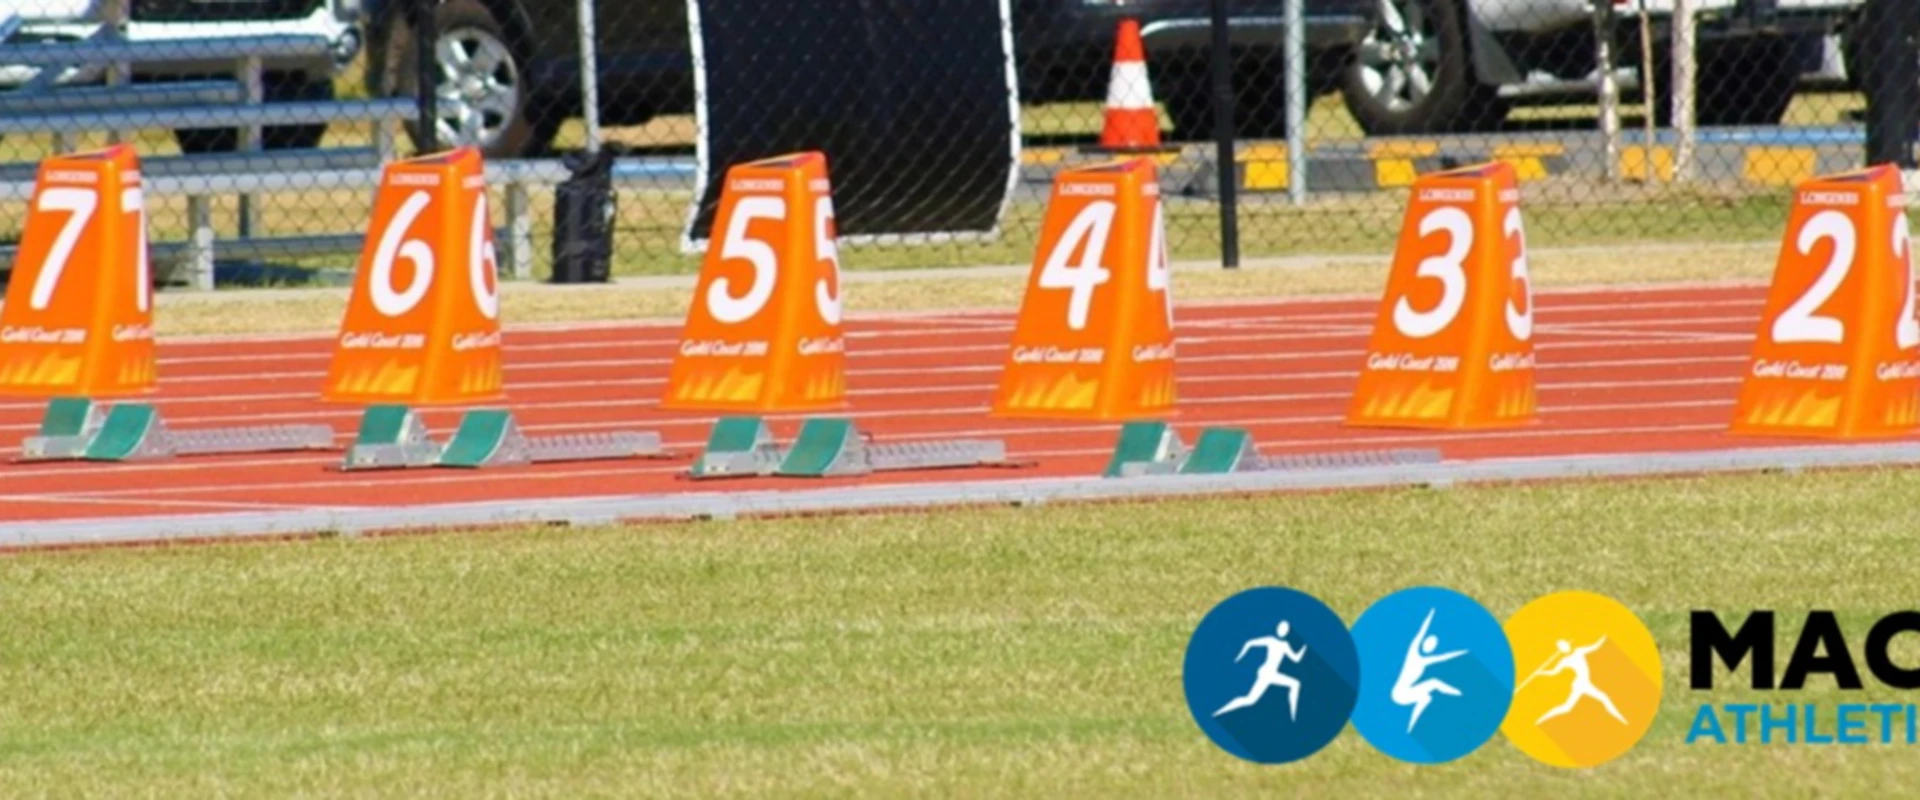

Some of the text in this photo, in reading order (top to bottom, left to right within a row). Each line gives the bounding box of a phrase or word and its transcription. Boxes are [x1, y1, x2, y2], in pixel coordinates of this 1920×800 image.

[30, 187, 99, 310] 7
[369, 190, 434, 316] 6
[707, 196, 786, 324] 5
[1038, 200, 1117, 330] 4
[1393, 206, 1474, 337] 3
[1503, 206, 1532, 341] 3
[1772, 210, 1857, 344] 2
